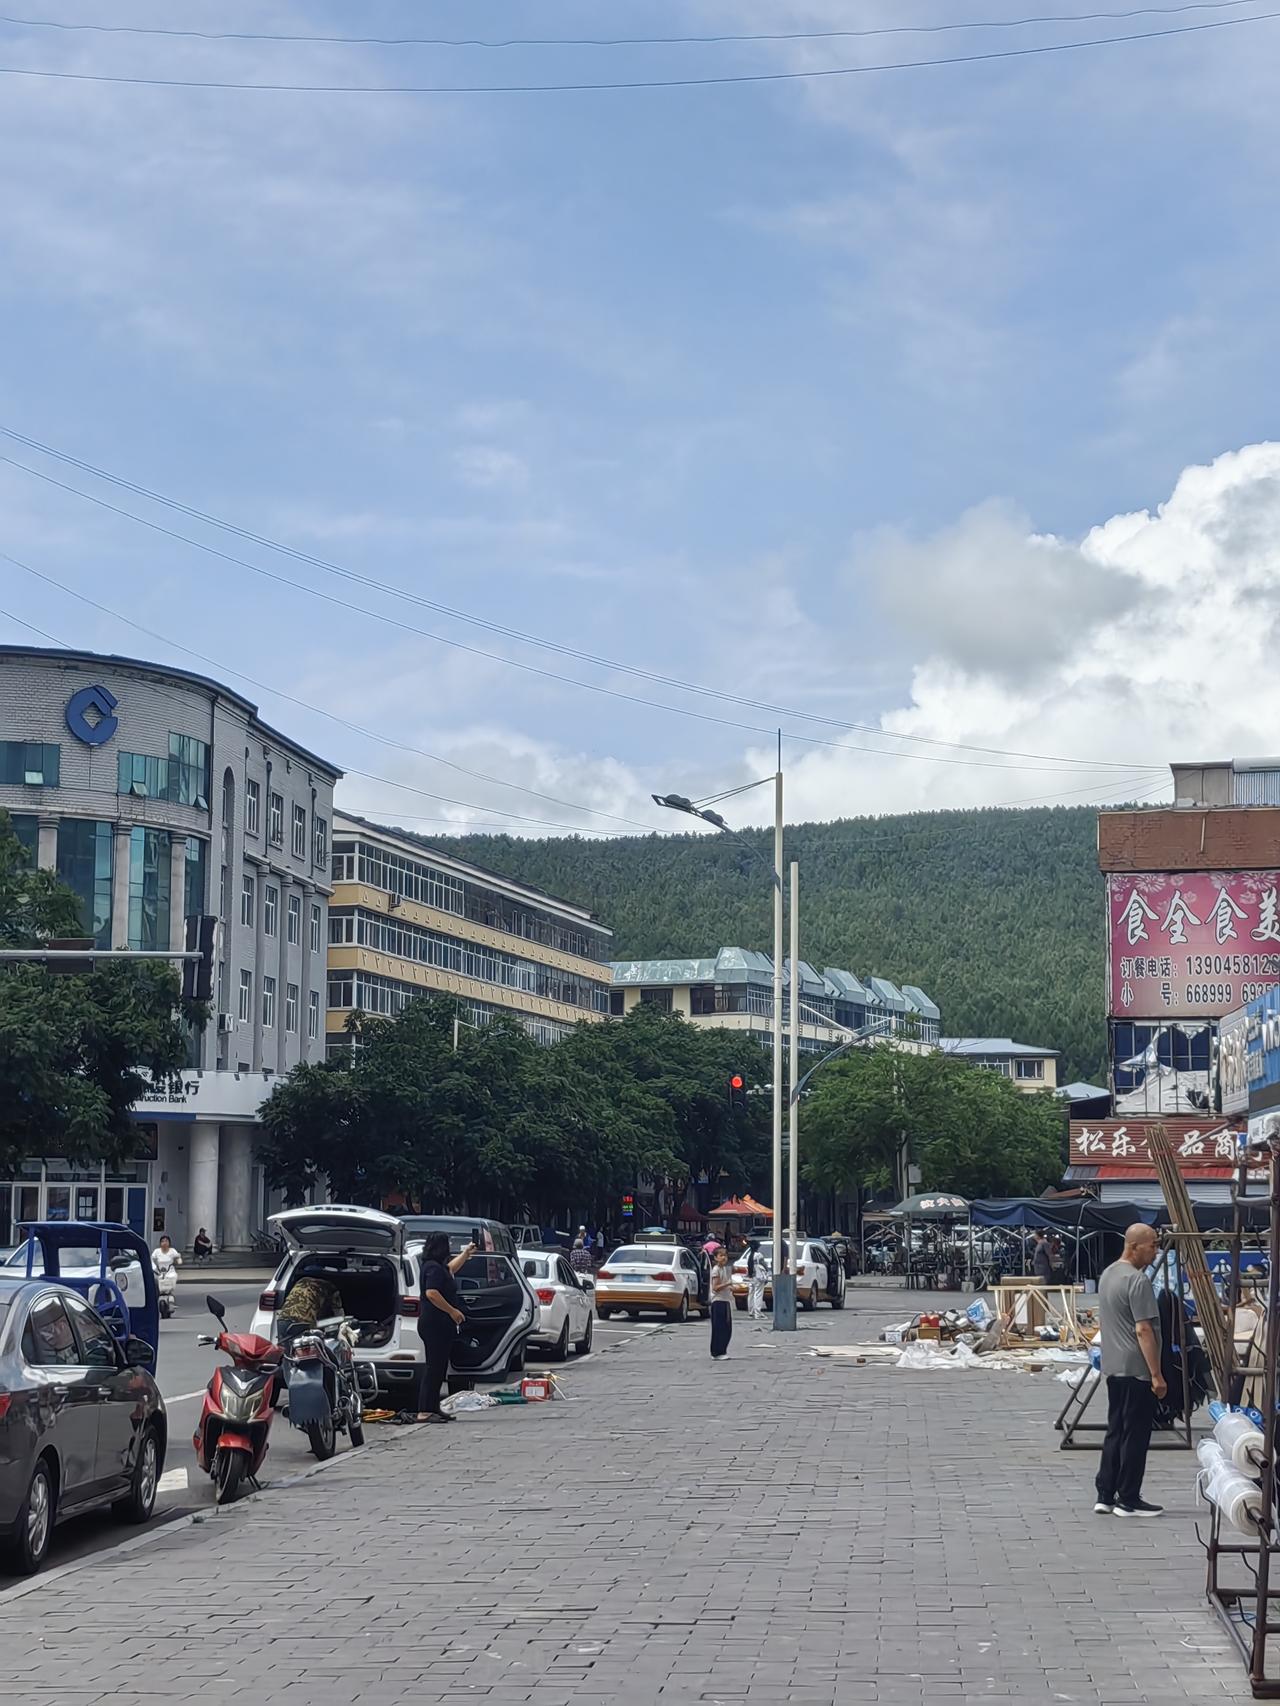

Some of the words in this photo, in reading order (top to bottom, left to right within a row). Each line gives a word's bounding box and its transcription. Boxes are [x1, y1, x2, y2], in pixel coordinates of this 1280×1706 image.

[1117, 887, 1280, 945] 食全食美
[1121, 982, 1134, 1007] 小
[1186, 983, 1232, 1003] 668999
[1241, 983, 1279, 1003] 693
[1075, 1126, 1263, 1162] 松乐品商
